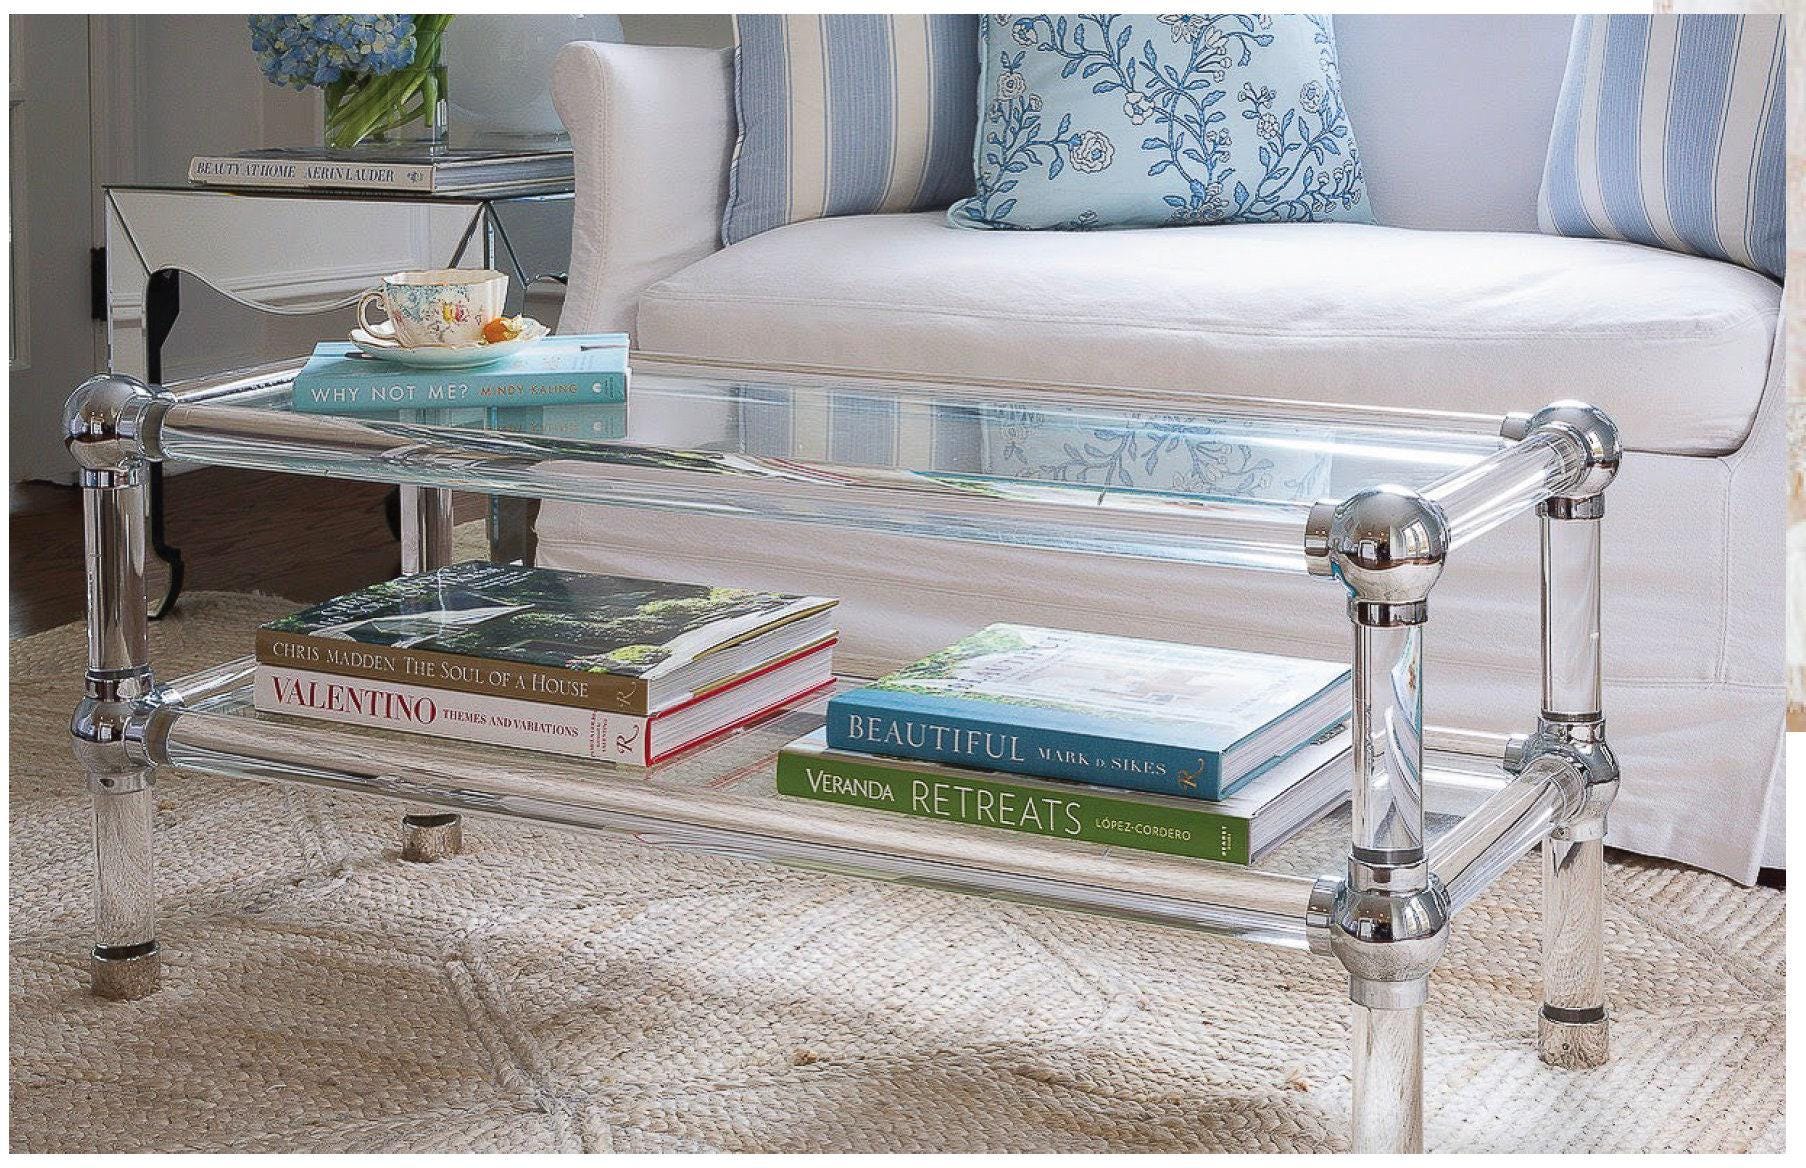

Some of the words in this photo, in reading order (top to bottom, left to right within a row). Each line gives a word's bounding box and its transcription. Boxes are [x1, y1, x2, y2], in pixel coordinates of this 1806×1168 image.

[196, 162, 238, 176] BEAUTY
[304, 165, 343, 180] AERIN
[345, 167, 395, 182] LAUDER
[311, 387, 360, 403] WHY
[371, 385, 416, 401] NOT
[428, 384, 469, 400] ME?
[481, 384, 524, 396] MINDY
[531, 383, 578, 395] KALING
[272, 642, 320, 661] CHRIS
[327, 649, 395, 672] MADDEN
[404, 656, 435, 677] THE
[441, 661, 484, 684] SOUL
[489, 671, 511, 687] OF
[515, 674, 526, 690] A
[532, 674, 589, 698] HOUSE
[272, 675, 438, 725] VALENTINO
[443, 709, 487, 725] THEMES
[489, 716, 513, 729] AND
[513, 719, 580, 738] VARIATIONS
[849, 714, 1024, 763] BEAUTIFUL
[1039, 747, 1090, 767] MARK
[1111, 758, 1168, 776] SIKES
[806, 768, 895, 802] VERANDA
[912, 780, 1082, 835] RETREATS
[1095, 817, 1192, 841] LÓPEZ-CORDERO
